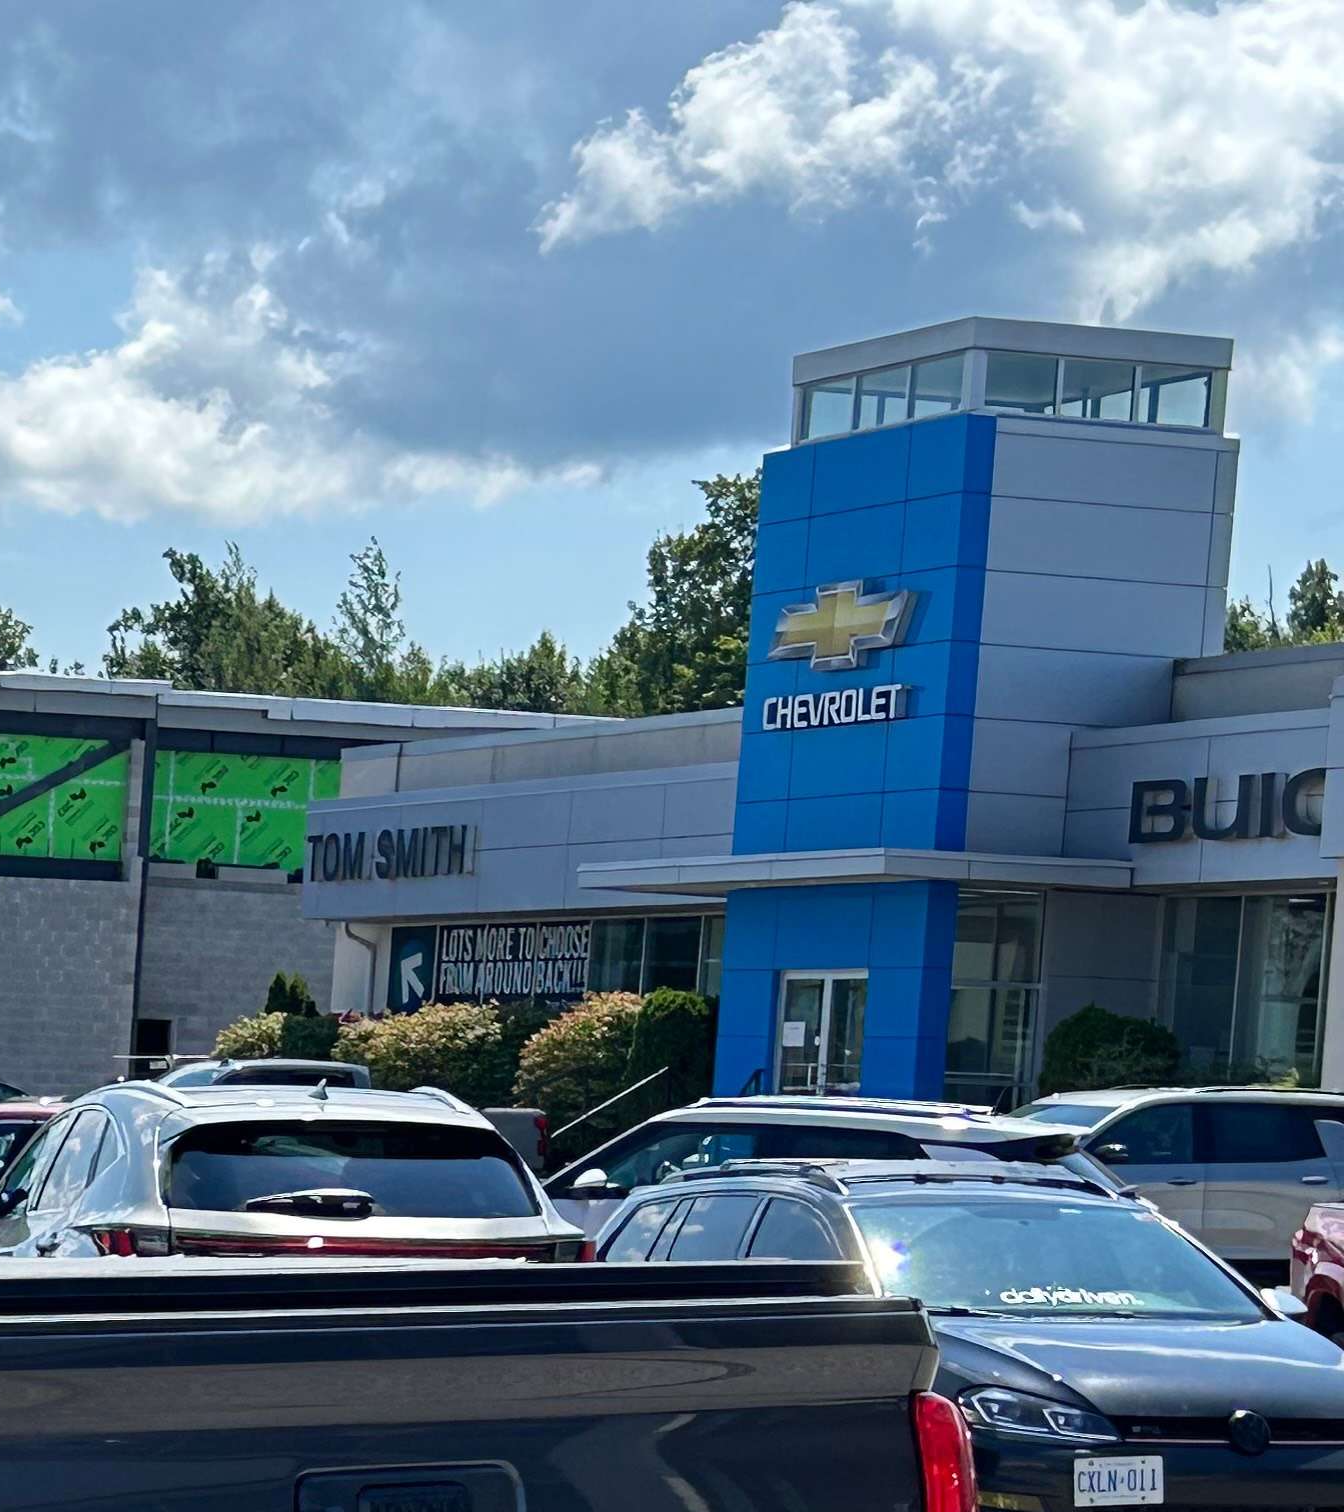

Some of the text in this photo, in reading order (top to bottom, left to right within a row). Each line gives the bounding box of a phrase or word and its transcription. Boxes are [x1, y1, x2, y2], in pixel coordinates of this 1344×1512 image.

[763, 683, 904, 731] CHEVROLET
[309, 825, 470, 882] TOM SMITH
[441, 924, 591, 962] LOTS MORE TO CHOOSE
[438, 961, 474, 995] FROM
[474, 960, 533, 994] AROUND
